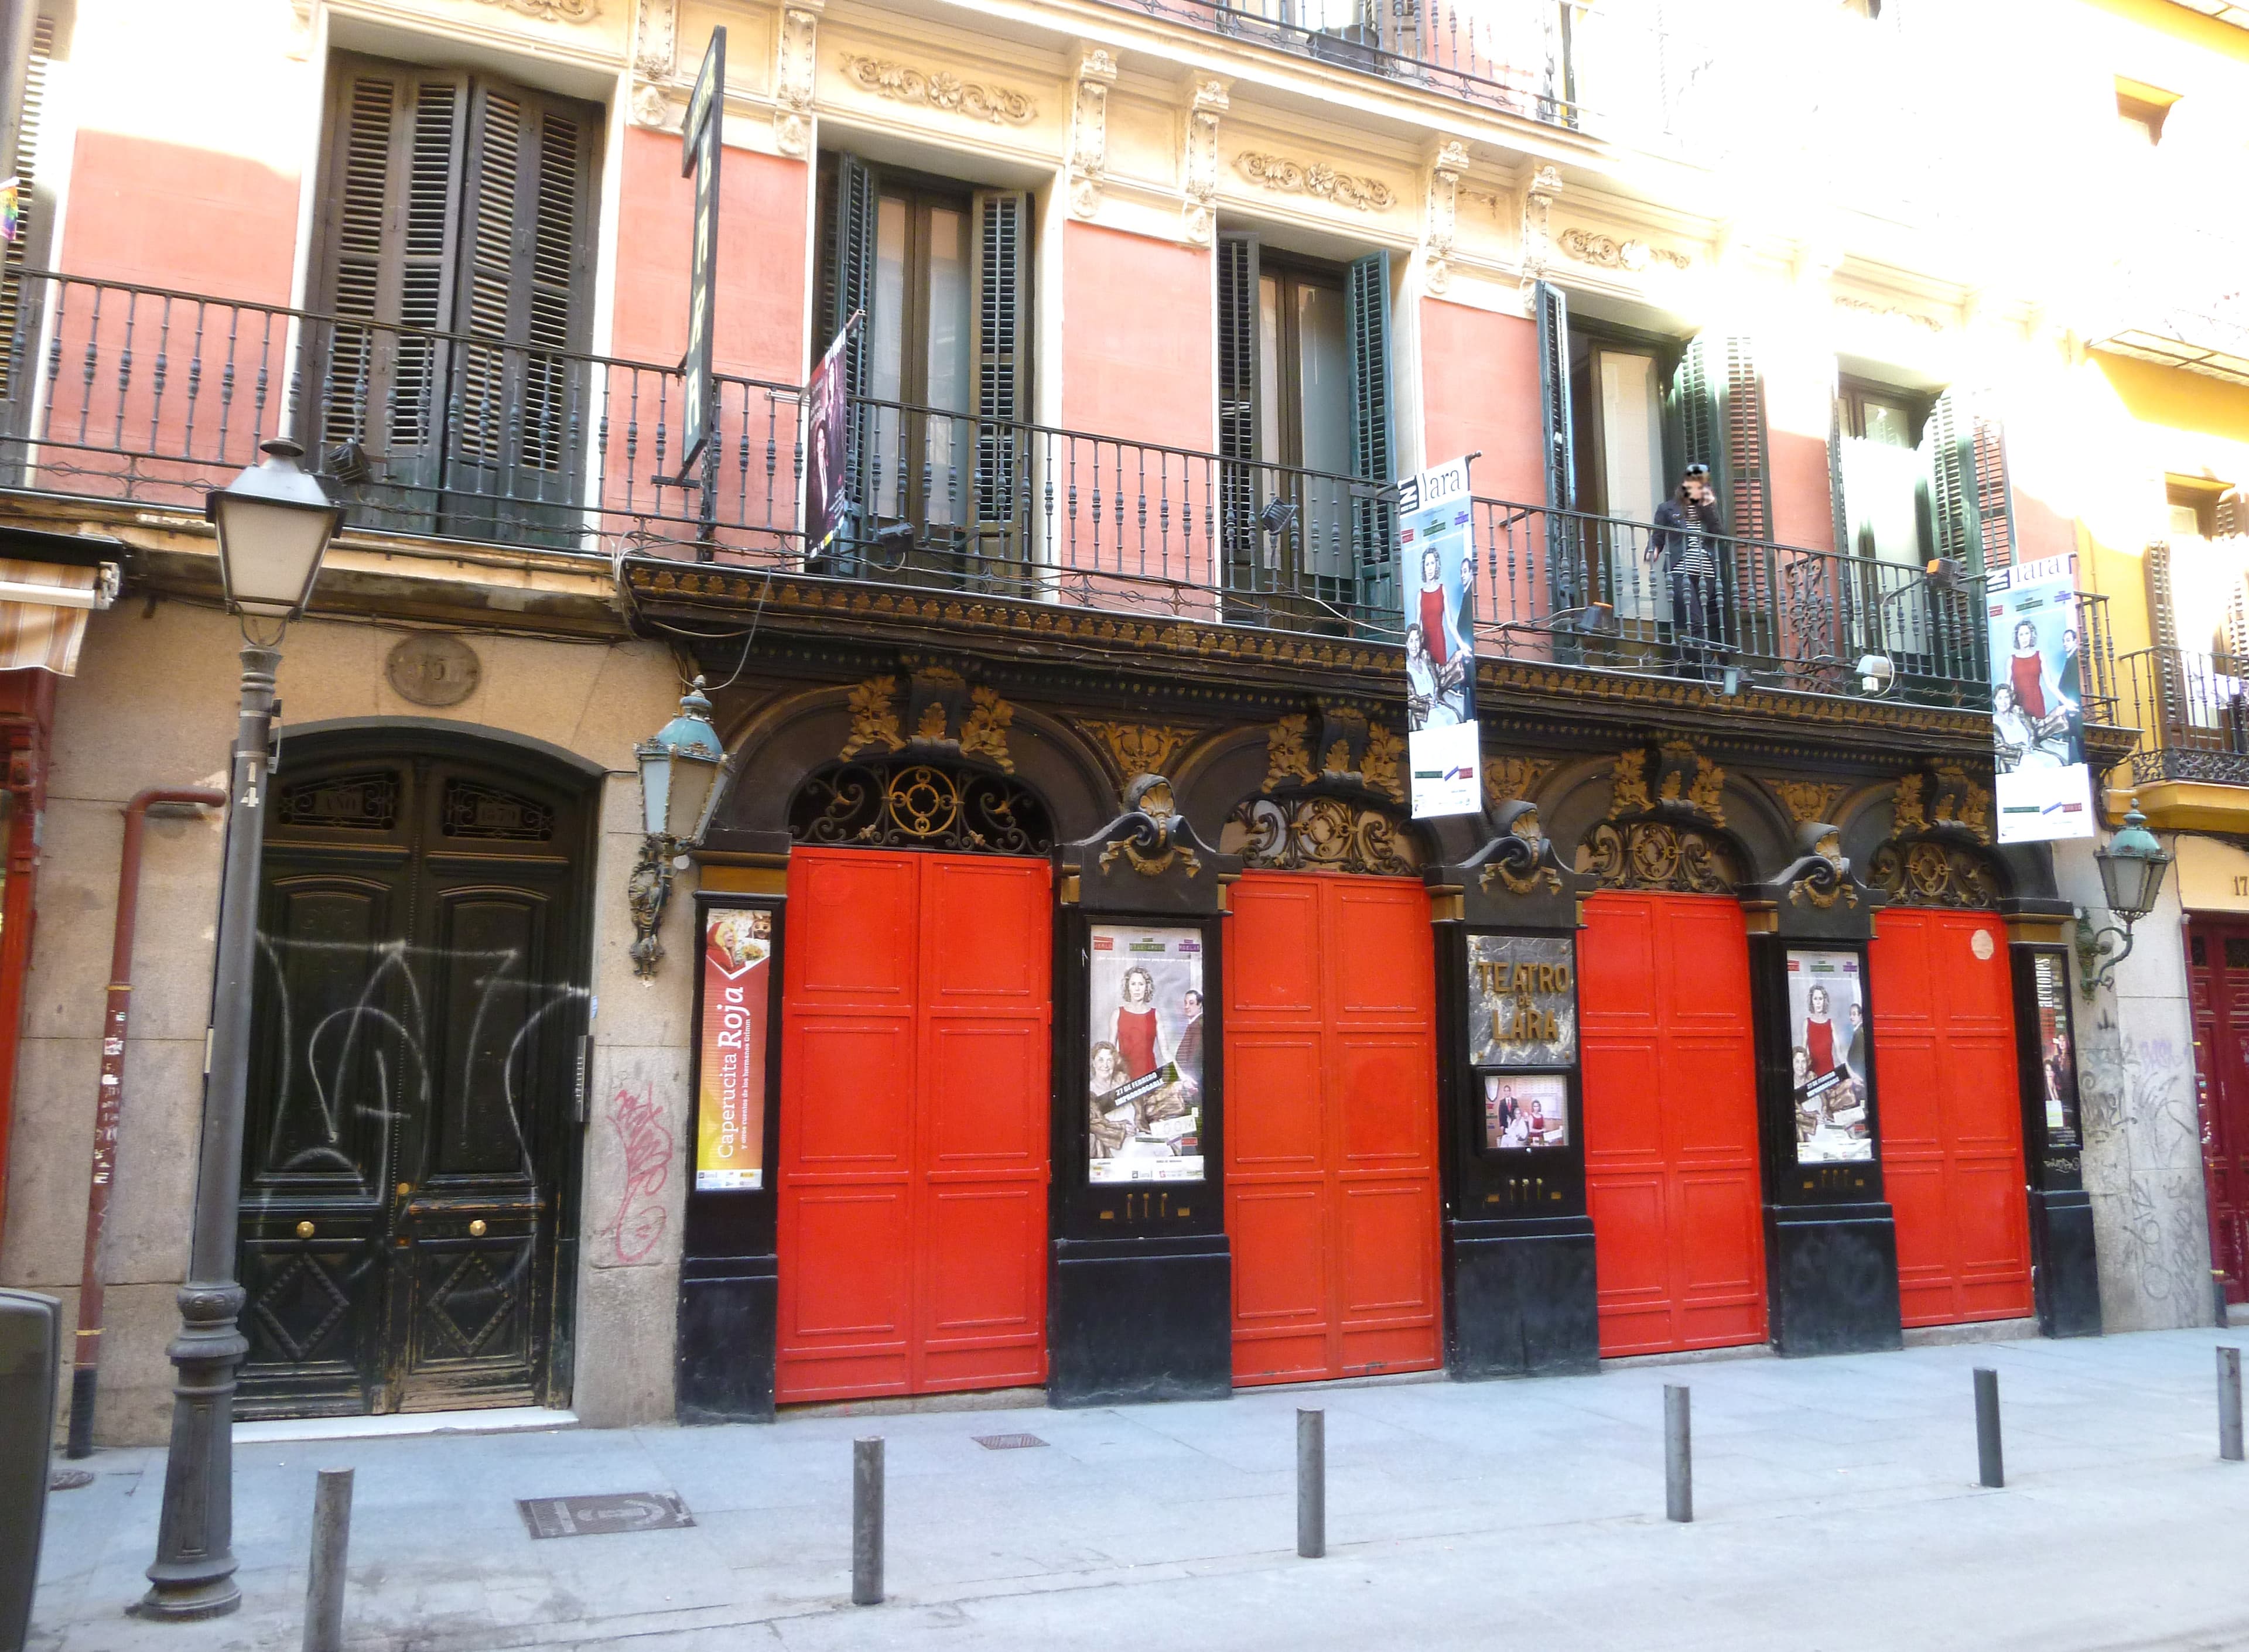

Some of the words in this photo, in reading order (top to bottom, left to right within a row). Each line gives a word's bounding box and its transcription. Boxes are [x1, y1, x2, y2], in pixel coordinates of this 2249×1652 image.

[1421, 470, 1461, 502] lara
[1478, 962, 1570, 993] TEATRO
[1517, 996, 1532, 1007] DE
[716, 986, 750, 1049] Roja
[1492, 1008, 1558, 1039] LARA
[742, 1089, 748, 1097] de
[1116, 1088, 1124, 1096] 27
[1124, 1083, 1132, 1093] DE
[1132, 1072, 1157, 1090] FEBRERO
[717, 1053, 739, 1158] Caperucita
